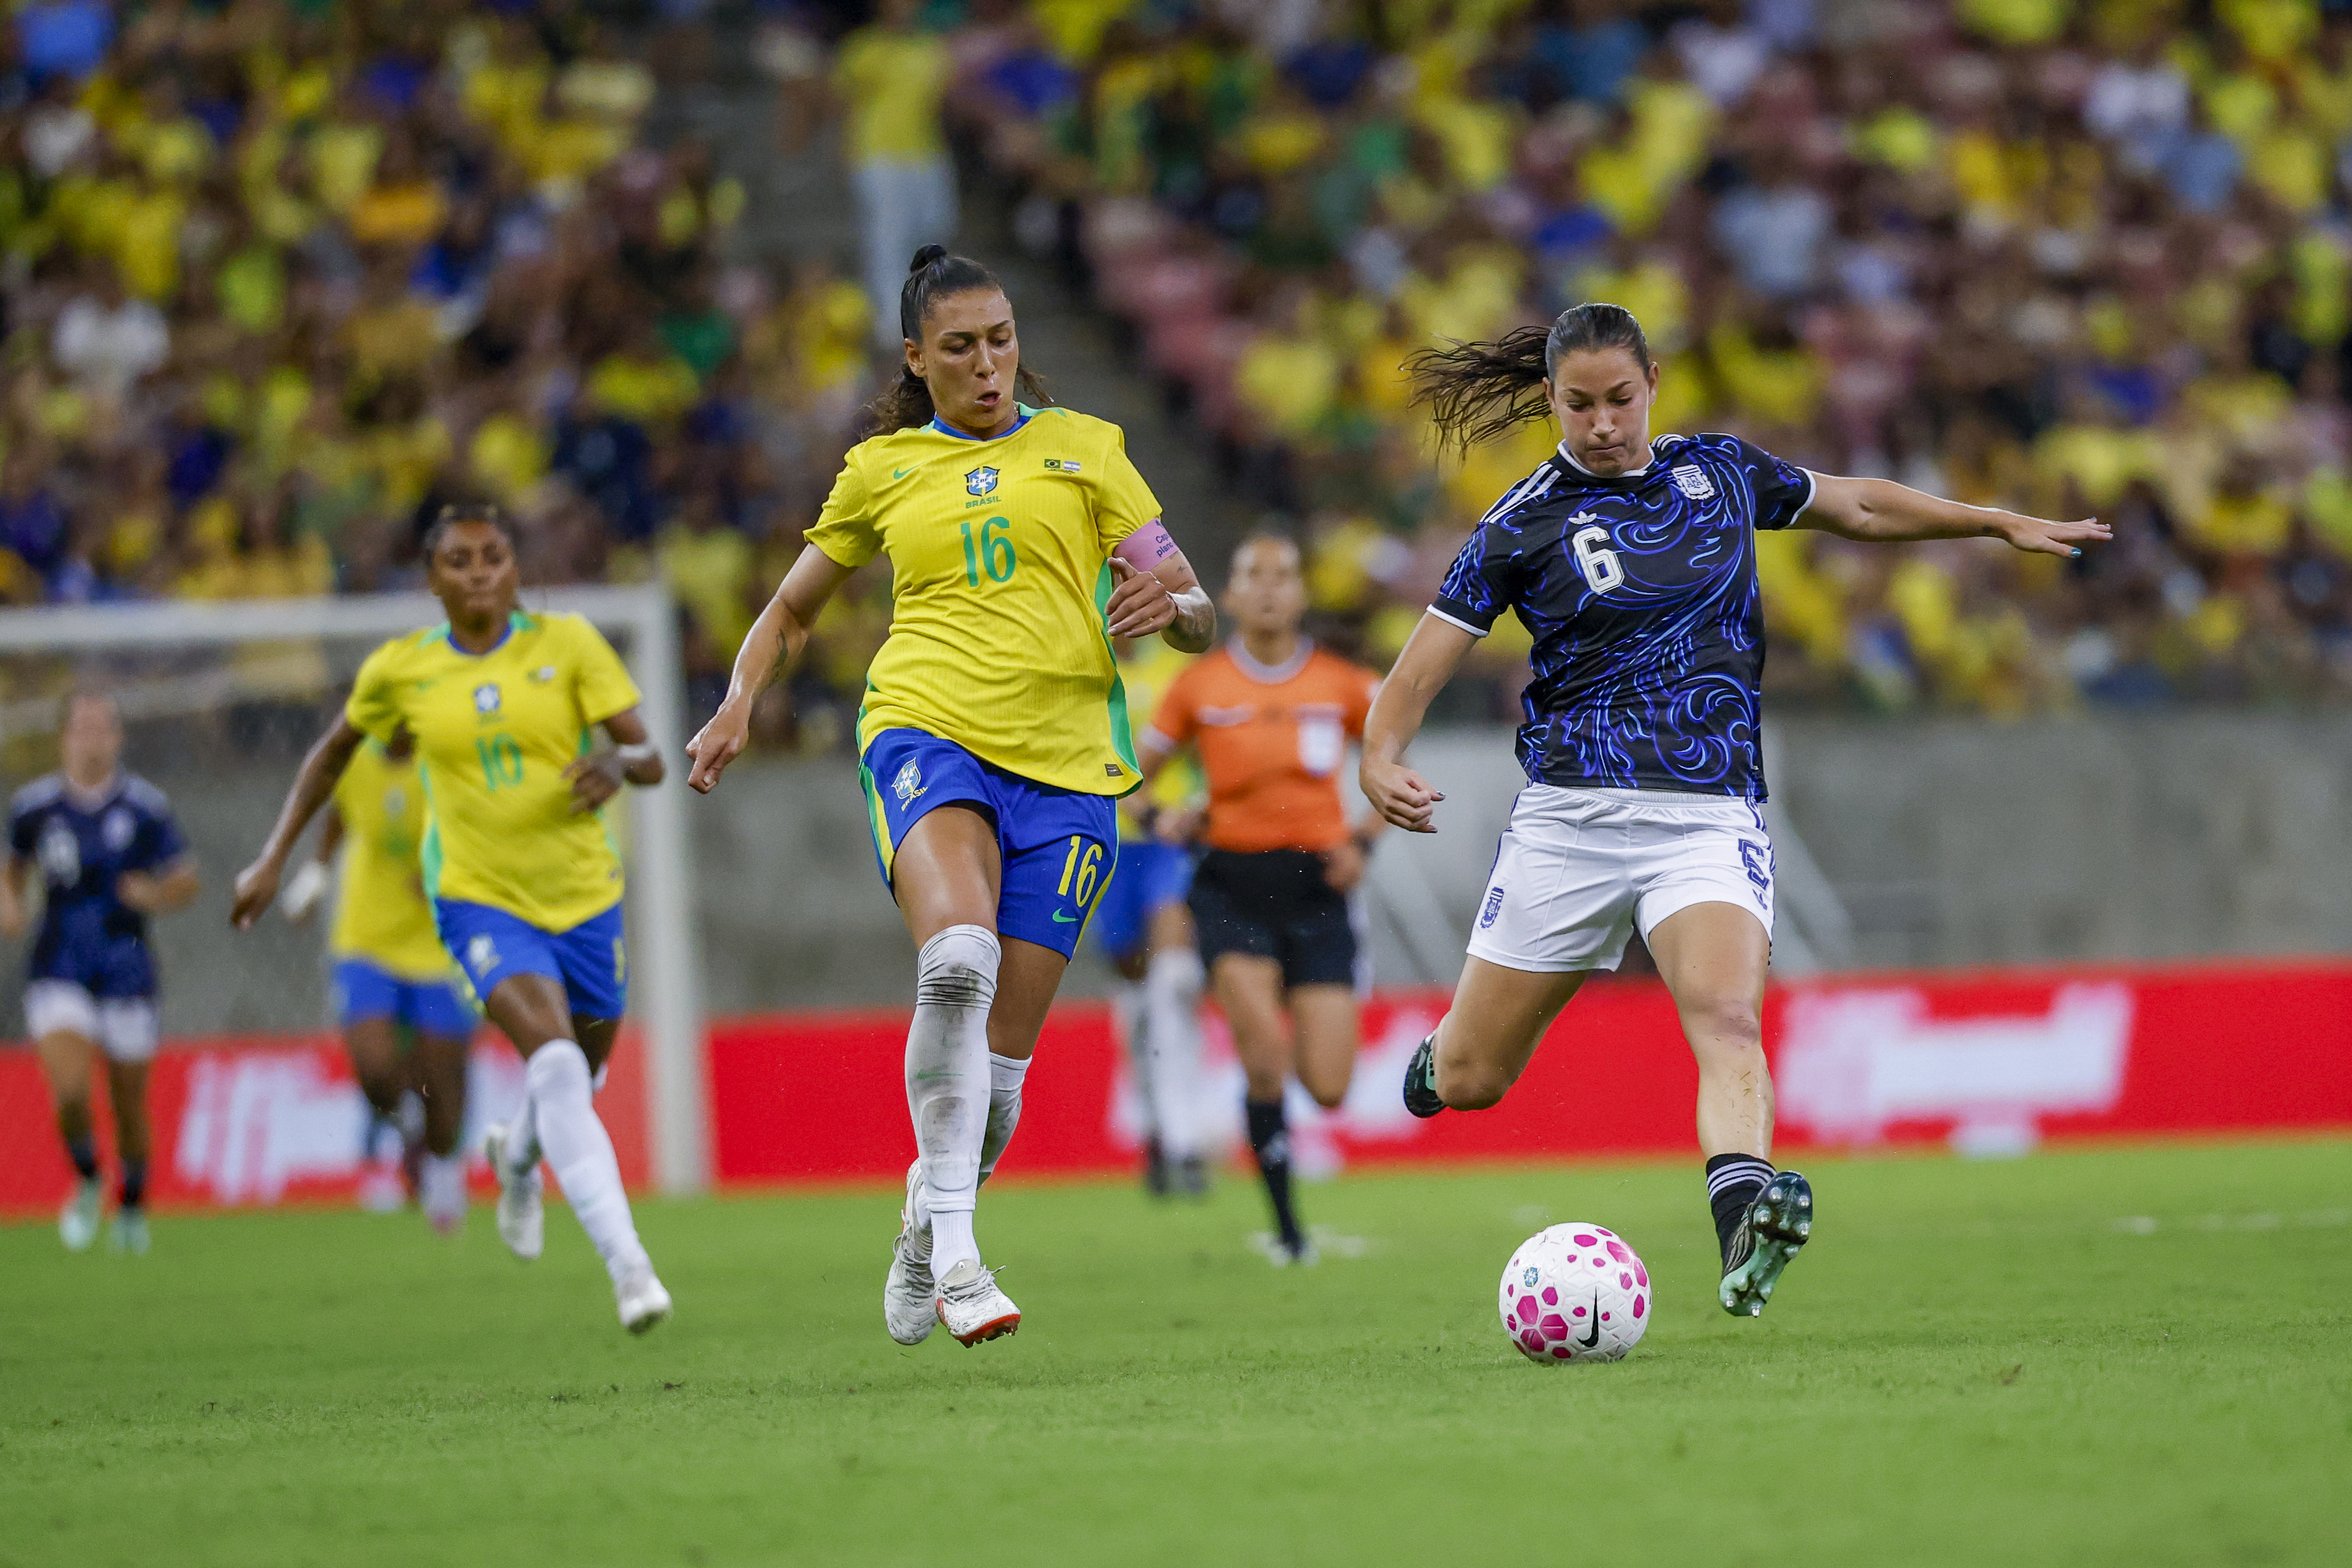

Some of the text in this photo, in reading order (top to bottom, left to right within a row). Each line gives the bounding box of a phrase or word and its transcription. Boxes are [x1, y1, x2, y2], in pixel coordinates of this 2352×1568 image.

[965, 496, 1002, 509] BRASIL
[960, 516, 1016, 587] 16
[1572, 526, 1625, 594] 6
[476, 733, 524, 791] 10
[901, 786, 928, 812] BRASIL
[1057, 835, 1102, 907] 16
